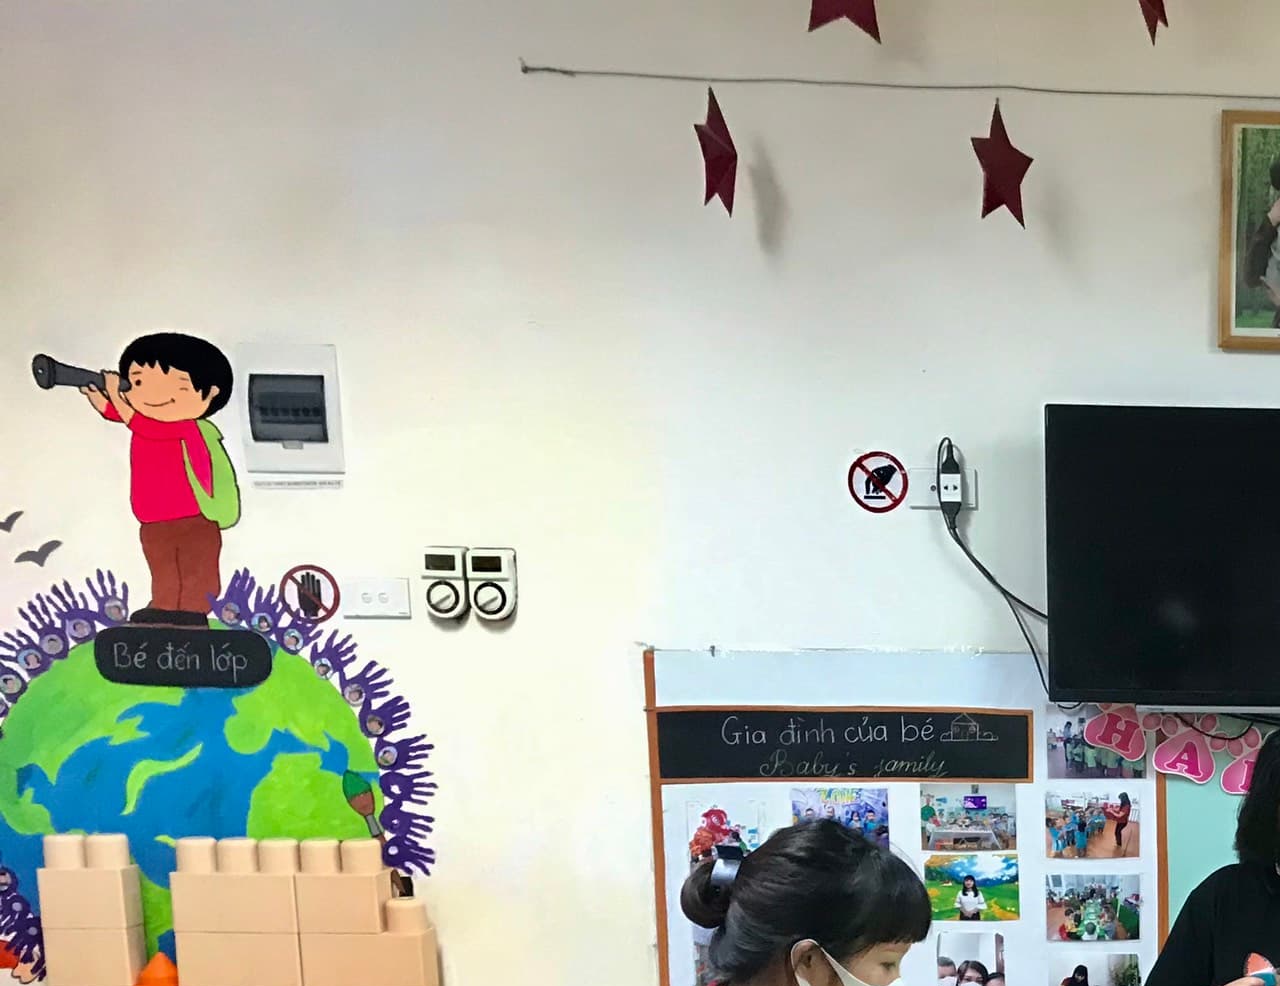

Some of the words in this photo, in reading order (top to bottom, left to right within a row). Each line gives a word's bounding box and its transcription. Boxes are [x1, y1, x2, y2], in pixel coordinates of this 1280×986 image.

[113, 640, 148, 669] Bé
[156, 641, 200, 670] đến
[210, 642, 249, 683] lớp
[721, 715, 767, 745] Gia
[779, 716, 836, 746] đình
[844, 715, 888, 744] của
[900, 715, 935, 742] bé
